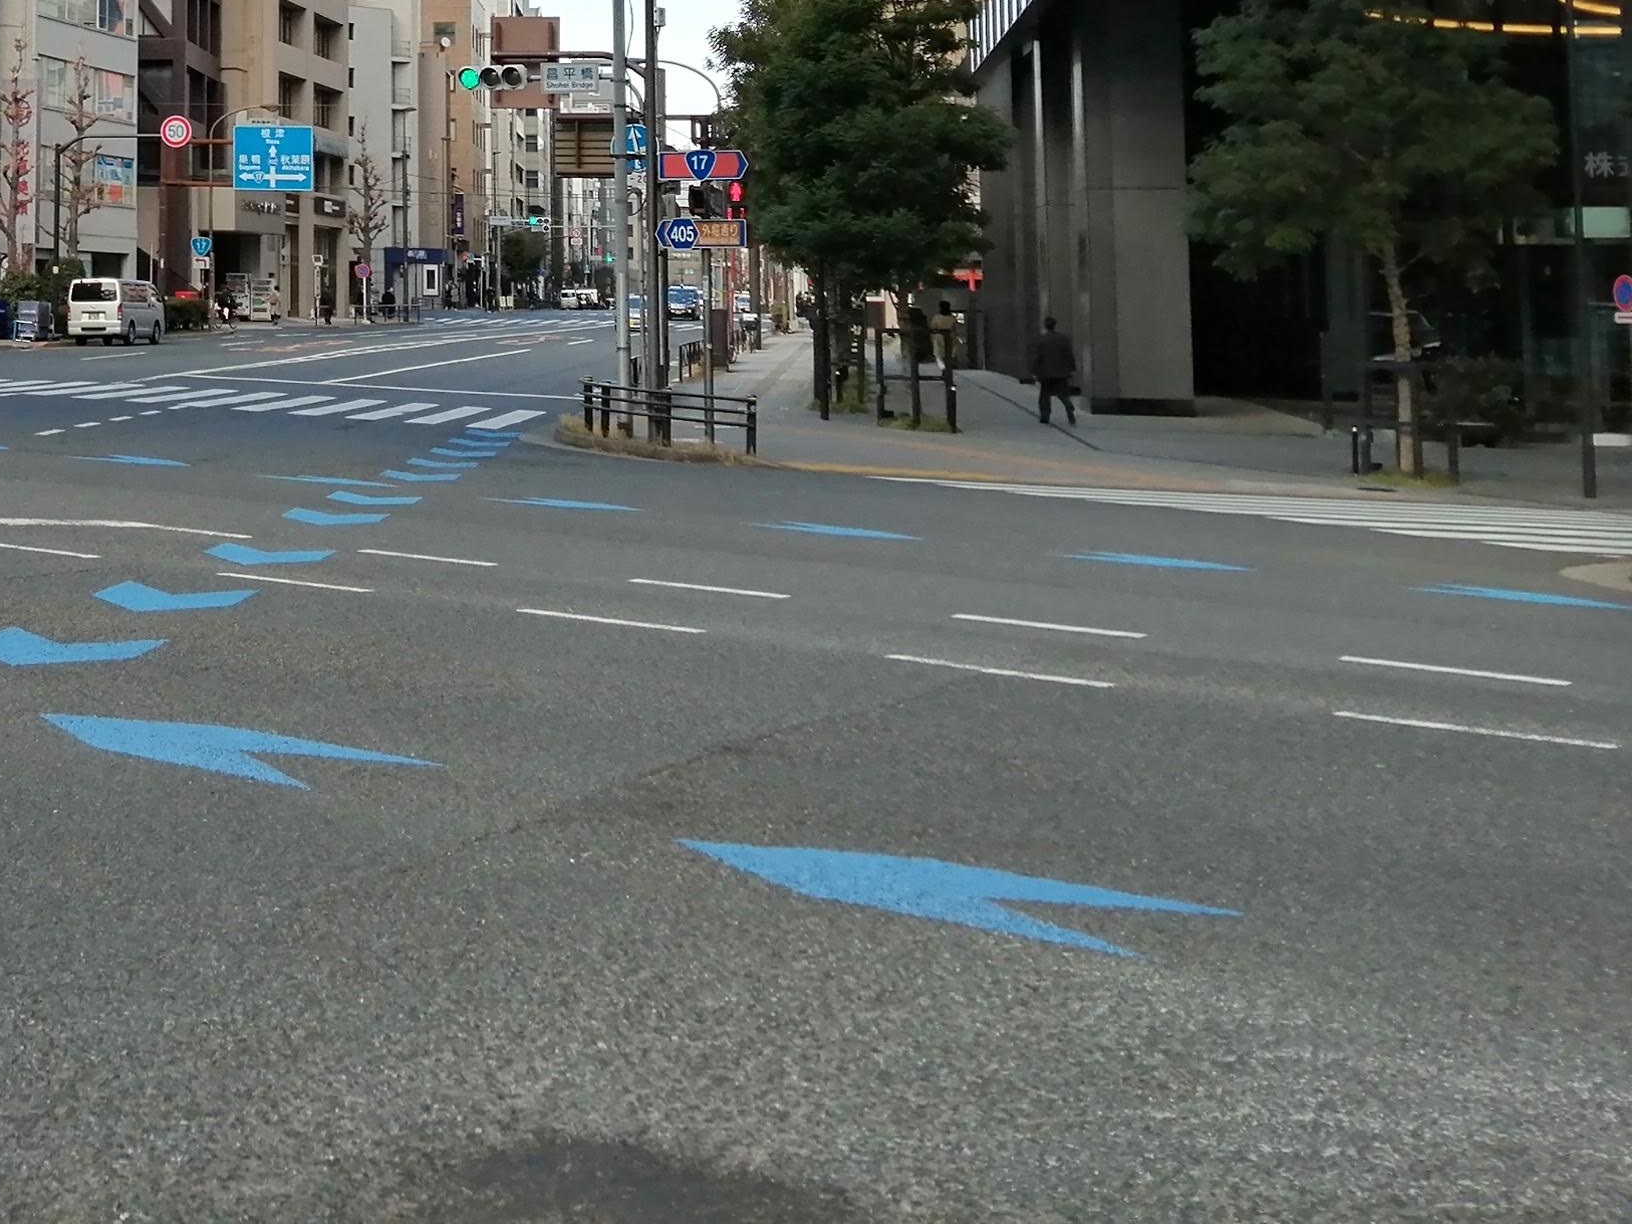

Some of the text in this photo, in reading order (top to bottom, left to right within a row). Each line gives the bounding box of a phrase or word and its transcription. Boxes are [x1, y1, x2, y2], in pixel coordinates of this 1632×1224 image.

[546, 67, 594, 81] 昌平橋
[572, 82, 594, 90] Bridge
[168, 125, 185, 138] 50
[691, 155, 709, 170] 17
[670, 226, 694, 242] 405
[196, 242, 207, 252] 17
